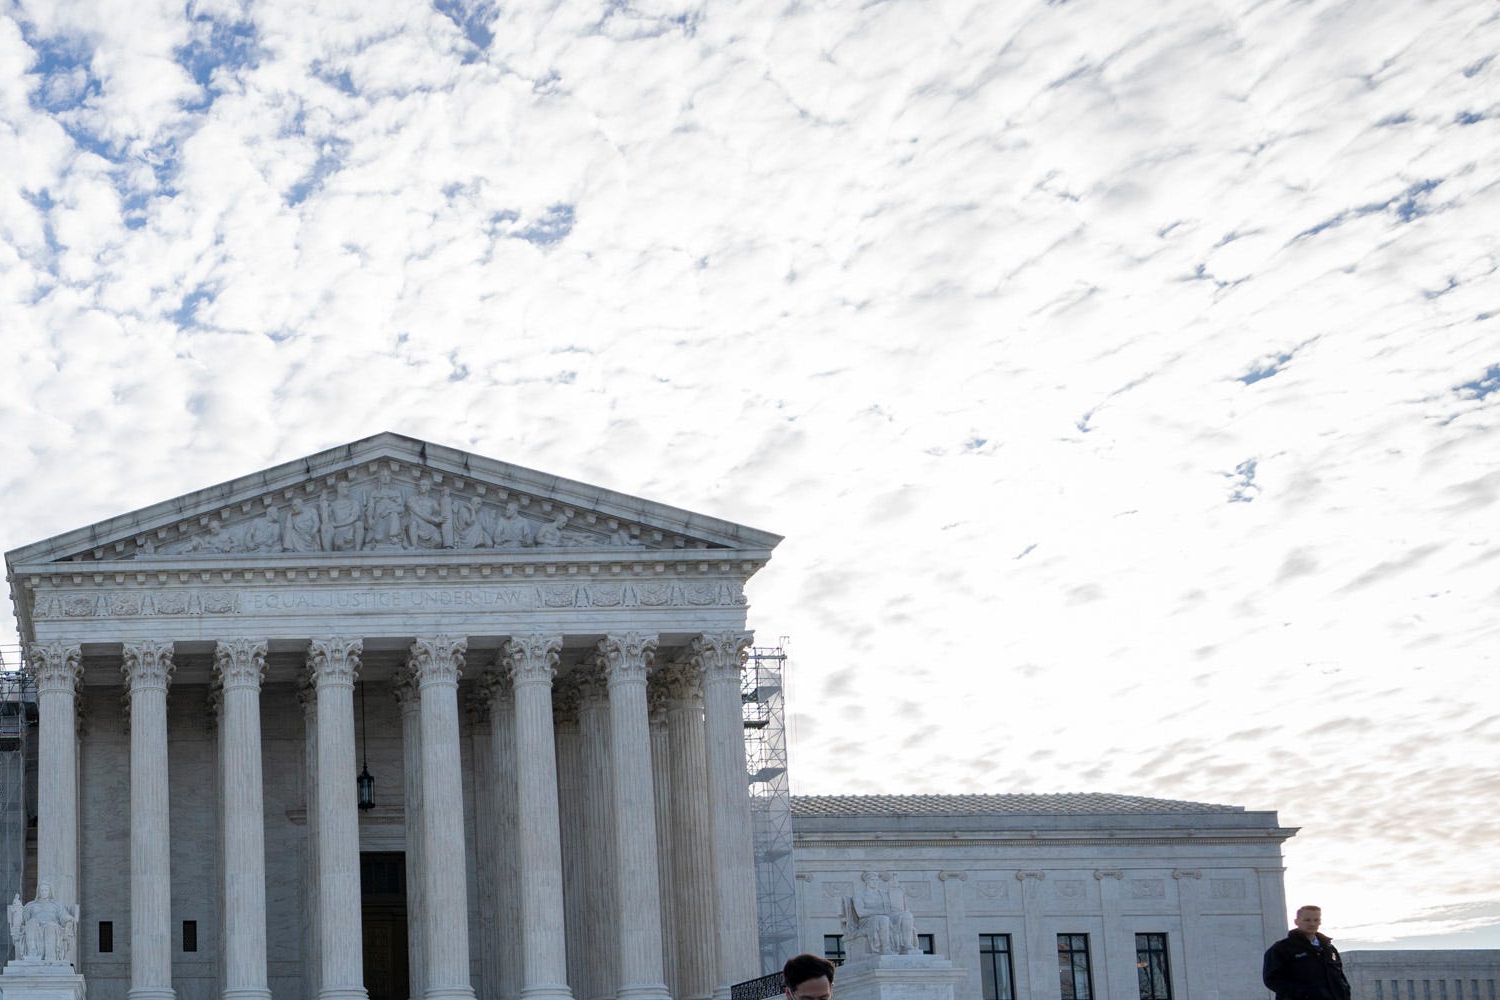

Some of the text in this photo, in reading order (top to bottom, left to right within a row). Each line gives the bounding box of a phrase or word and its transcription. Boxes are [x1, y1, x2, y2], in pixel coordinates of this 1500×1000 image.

[254, 590, 522, 608] EQUAL JUSTICE UNDER LAW
